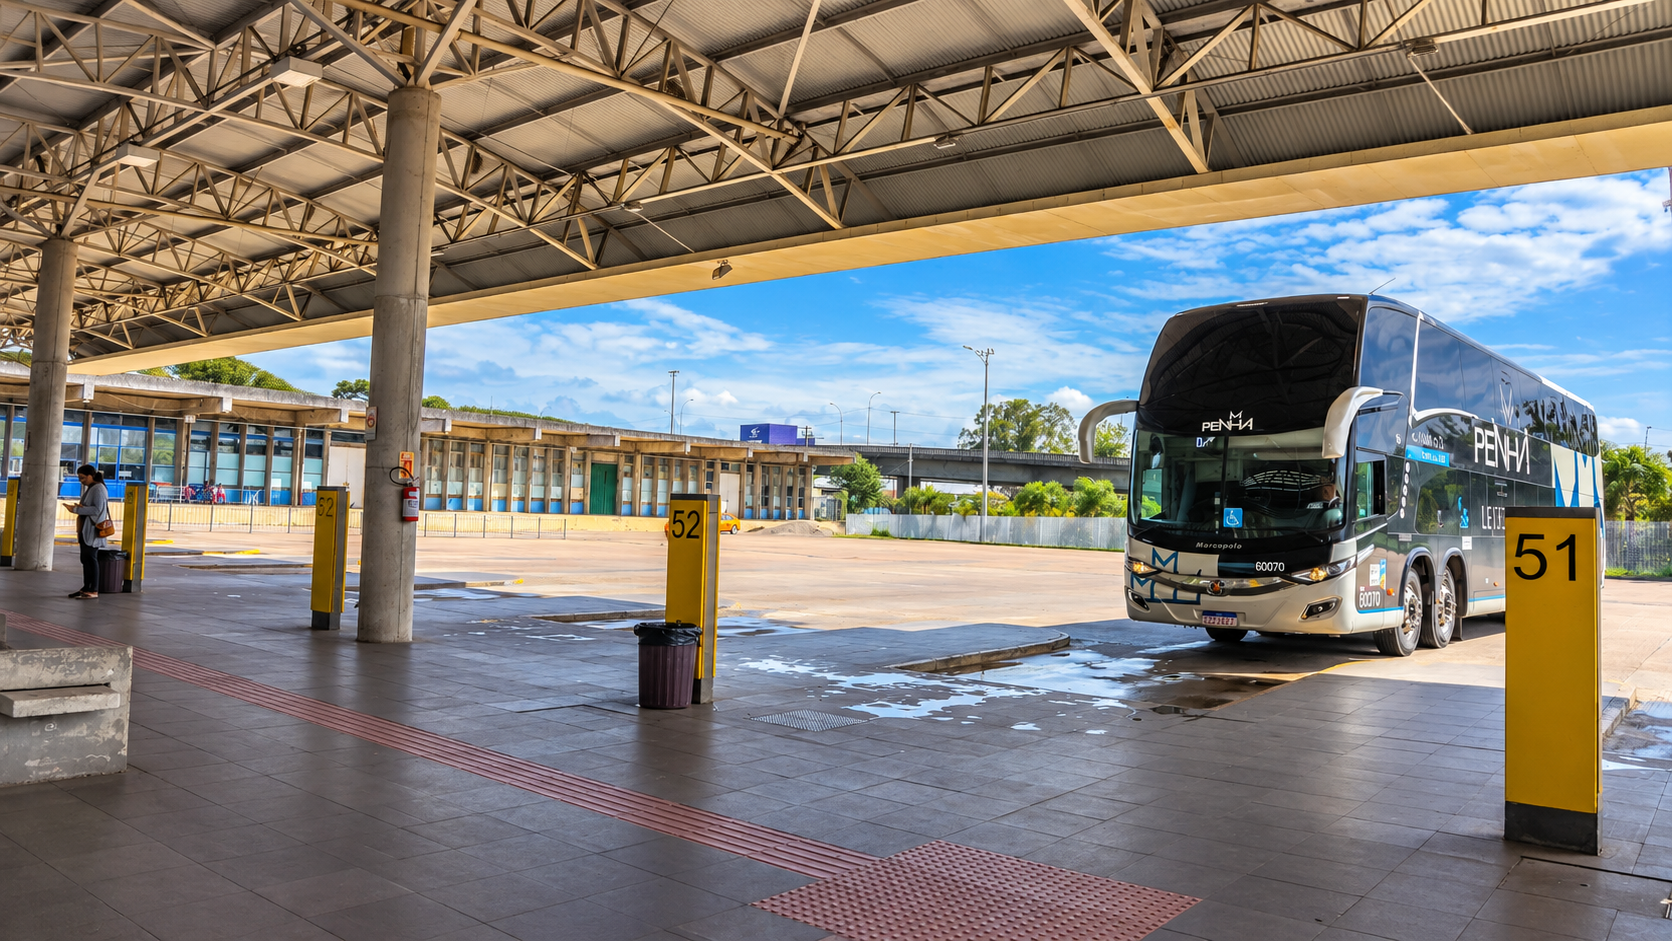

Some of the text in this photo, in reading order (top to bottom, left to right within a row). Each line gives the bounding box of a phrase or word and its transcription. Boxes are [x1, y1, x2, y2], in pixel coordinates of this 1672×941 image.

[1201, 416, 1254, 432] PENHA
[1474, 417, 1530, 475] PENHA
[671, 509, 700, 539] 52
[1195, 542, 1242, 550] Marcopolo
[1513, 533, 1576, 581] 51
[1255, 561, 1285, 572] 60070
